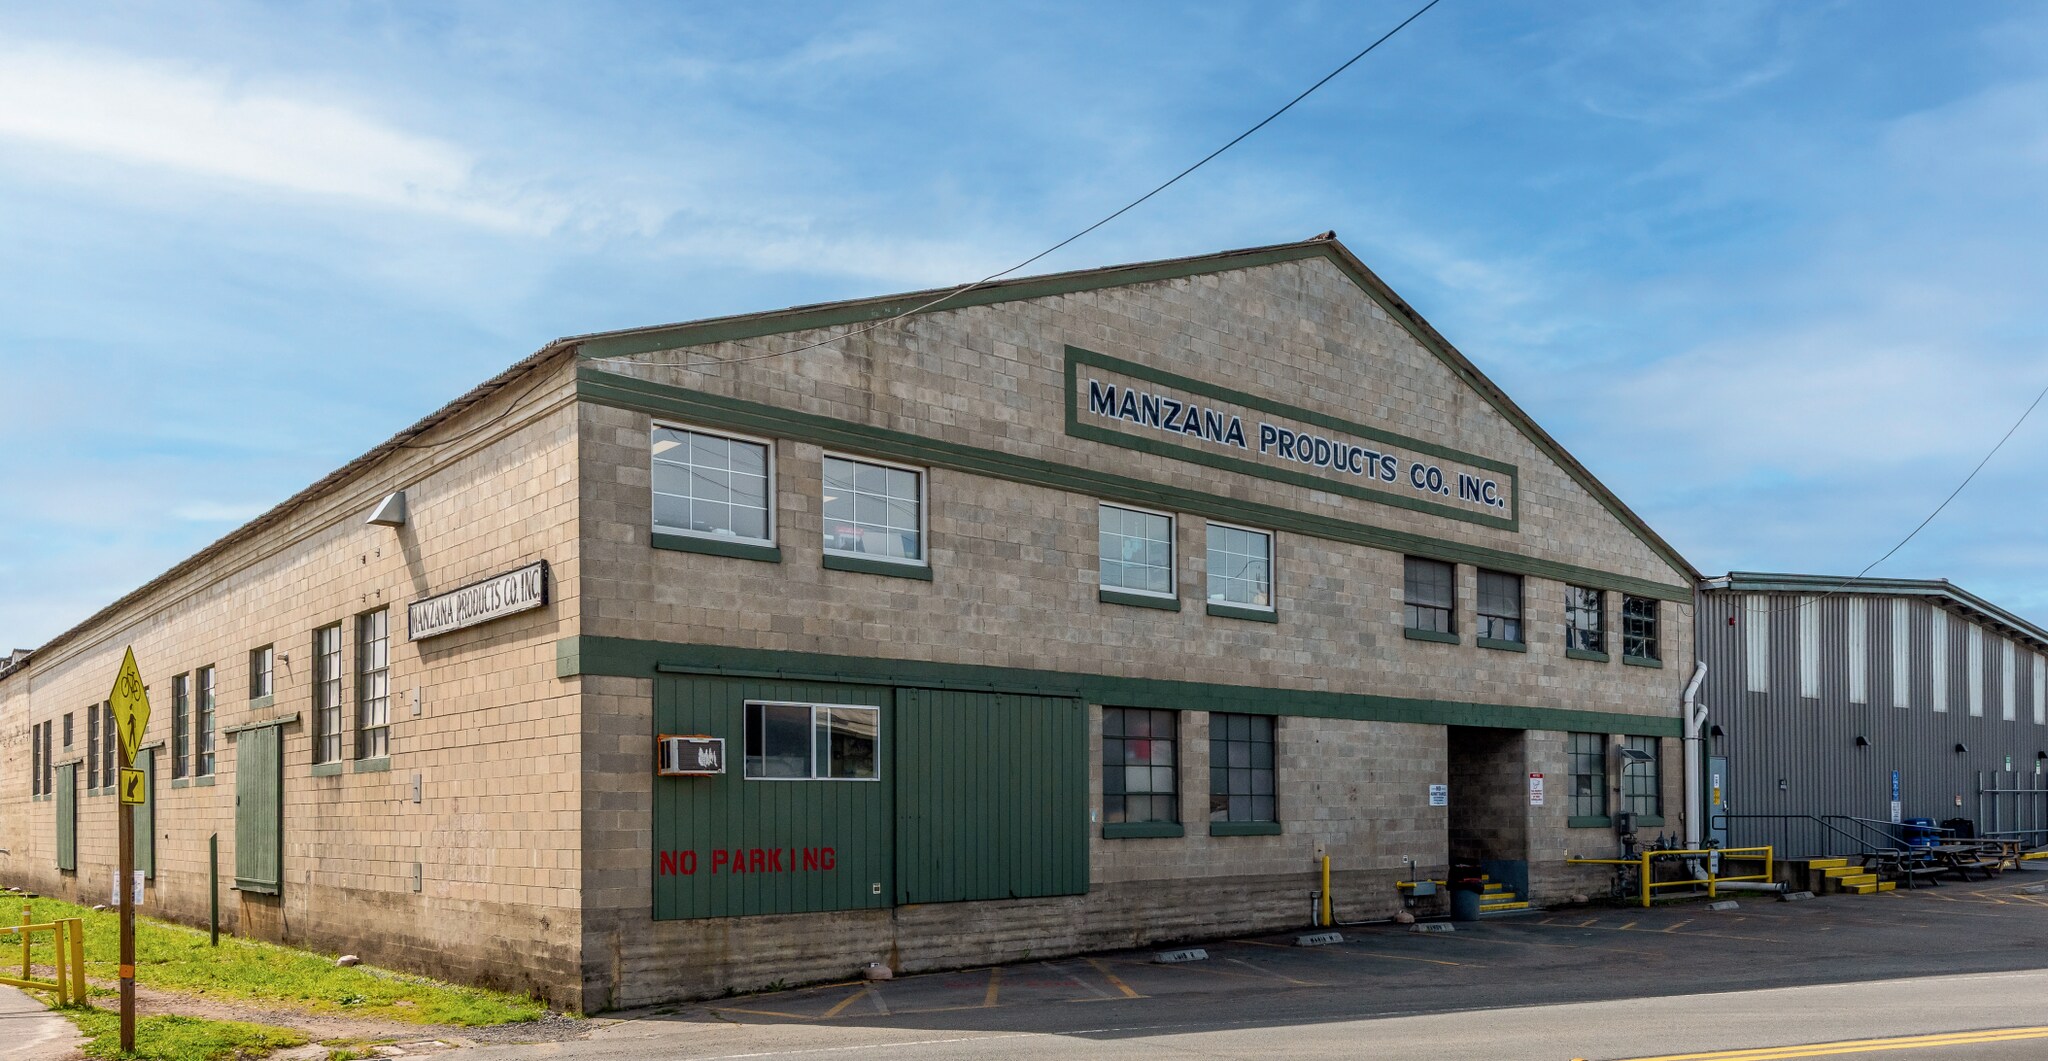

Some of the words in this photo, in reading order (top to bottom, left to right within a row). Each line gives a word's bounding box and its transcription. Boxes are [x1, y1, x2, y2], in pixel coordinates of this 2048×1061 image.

[1088, 378, 1249, 449] MANZANA
[1259, 422, 1398, 483] PRODUCTS
[1409, 462, 1450, 497] CO.
[1458, 473, 1506, 509] INC.
[411, 600, 453, 634] MANZANA
[456, 582, 500, 623] PRODUCTS
[660, 850, 697, 876] NO
[712, 847, 836, 875] PARKING
